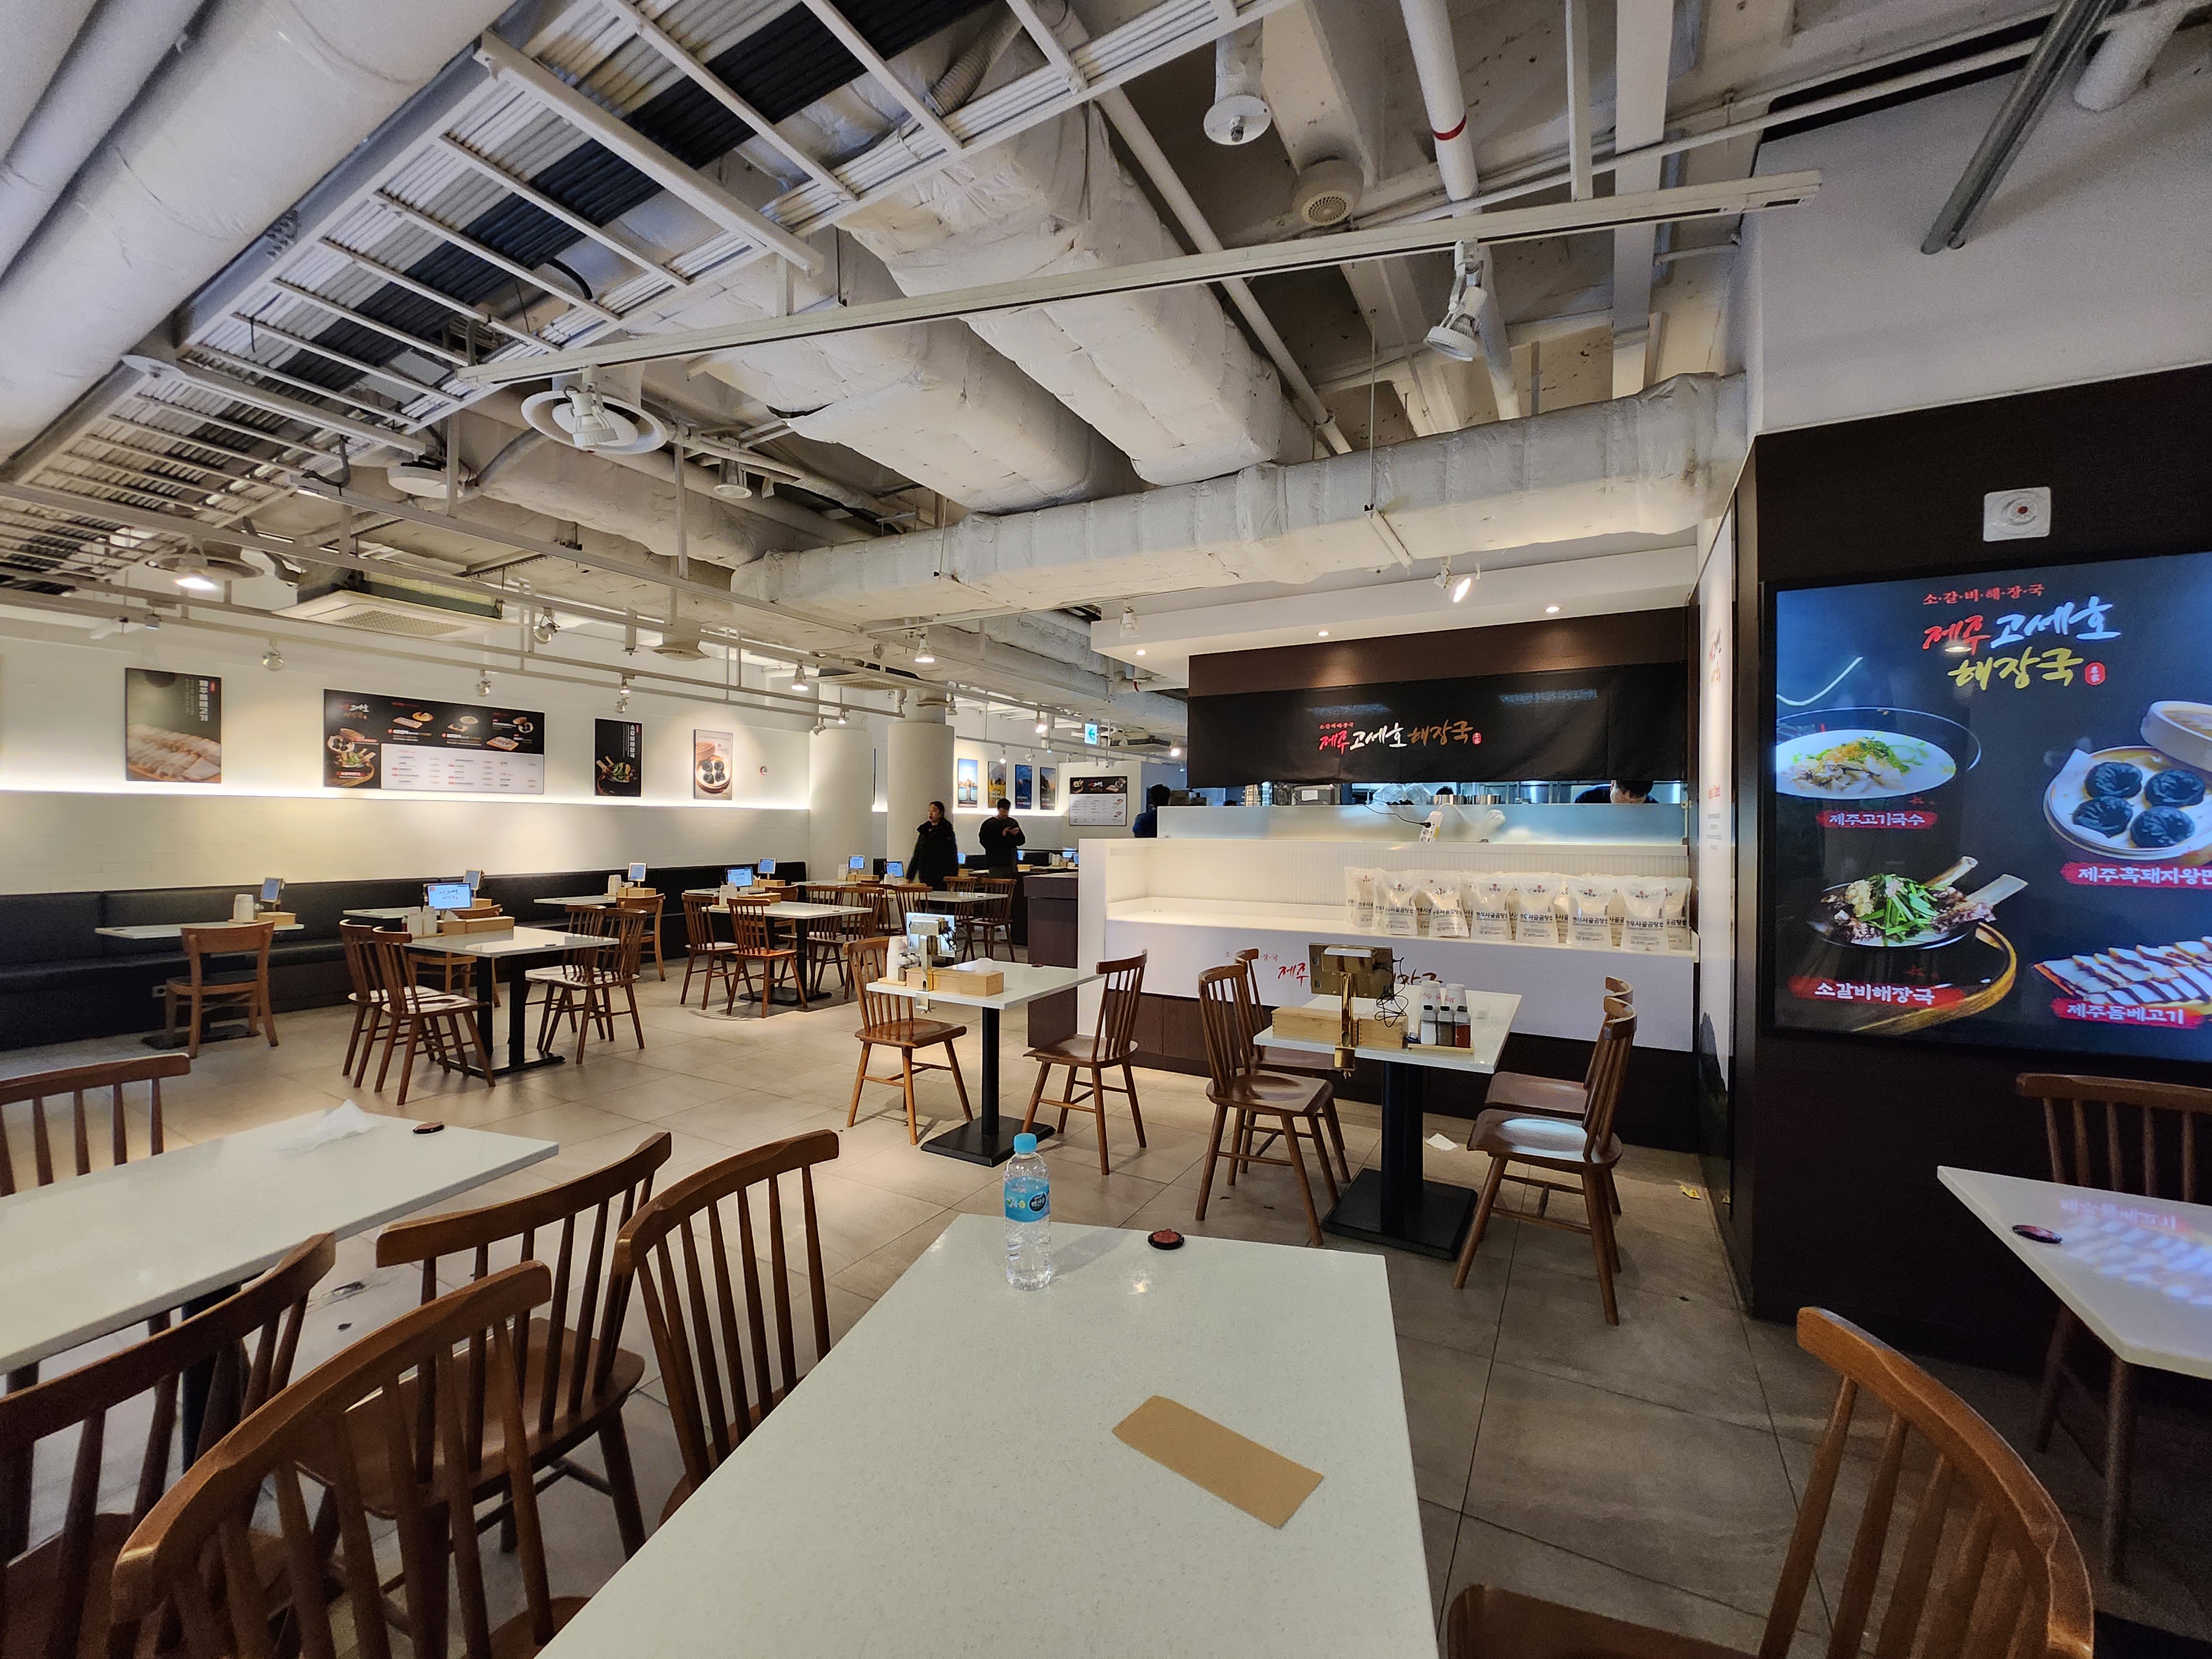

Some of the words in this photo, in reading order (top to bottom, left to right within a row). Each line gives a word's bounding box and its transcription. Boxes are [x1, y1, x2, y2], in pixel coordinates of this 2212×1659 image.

[1922, 614, 1991, 656] 제주
[1990, 596, 2121, 649] 고세호
[1947, 646, 2084, 691] 해장국
[1318, 730, 1350, 755] 제주
[1349, 722, 1408, 751] 고세호
[1407, 719, 1474, 747] 해장국
[1829, 812, 1926, 827] 제주고기국수
[1277, 962, 1310, 988] 제주
[1814, 982, 1936, 1005] 소갈비해장국
[2067, 1002, 2184, 1025] 제주돔베고기
